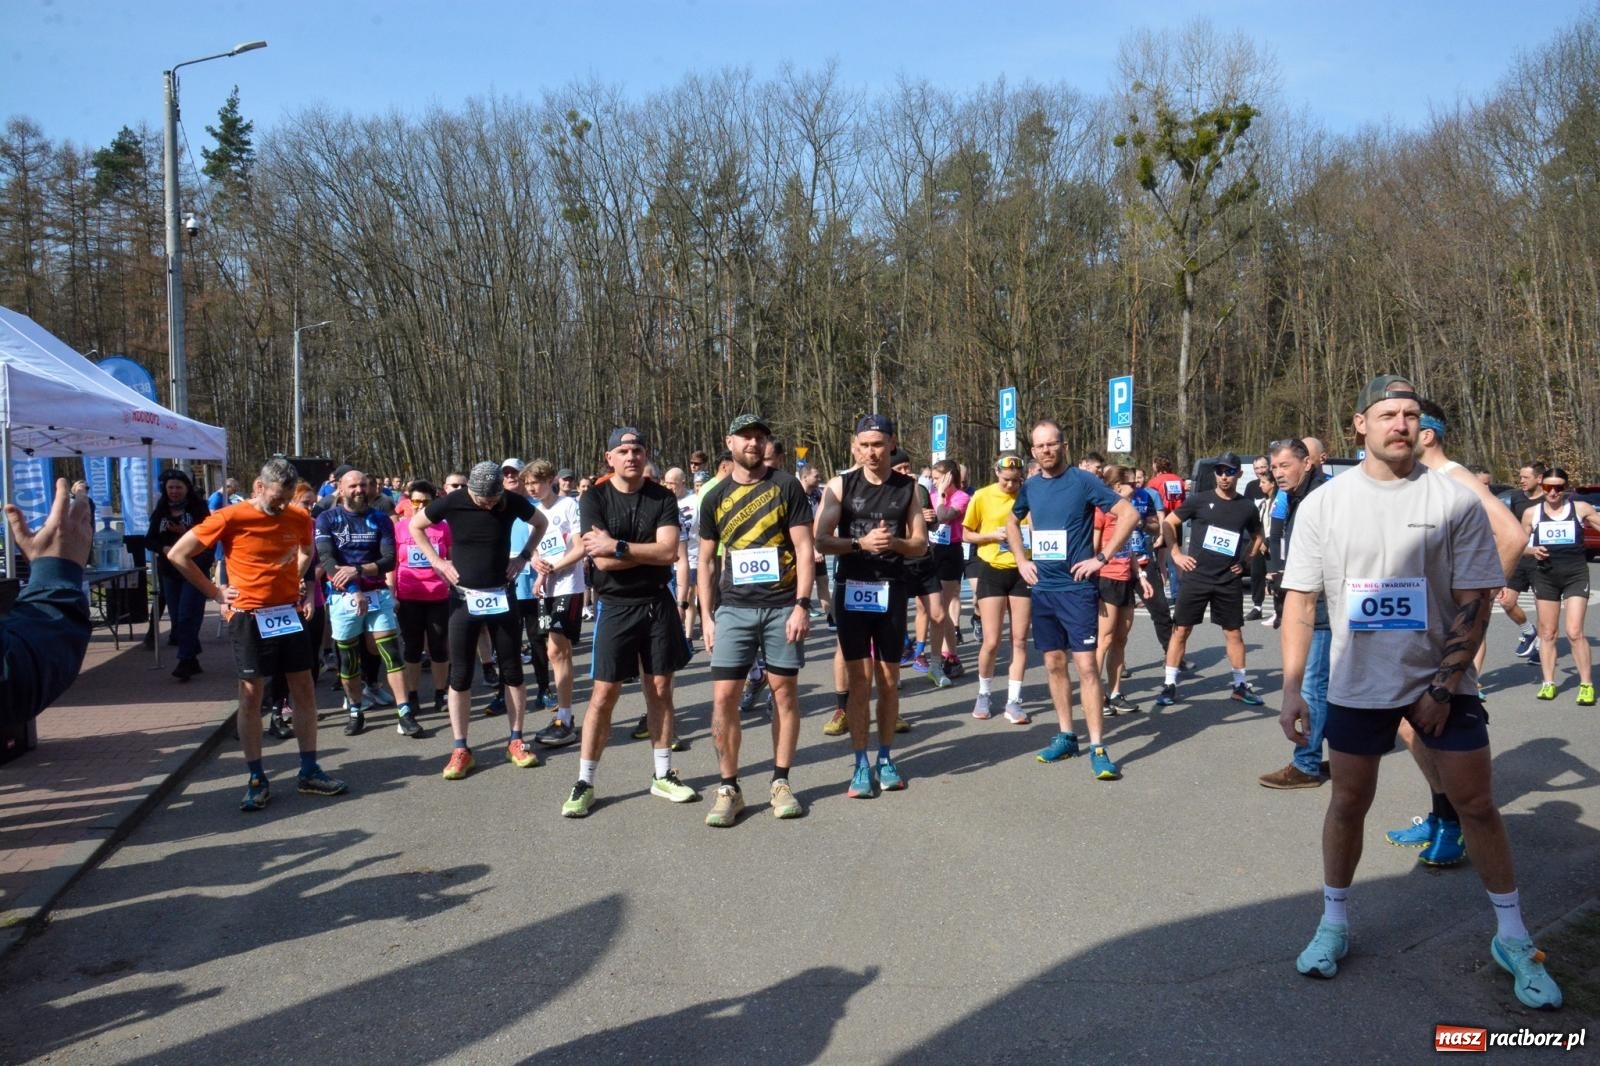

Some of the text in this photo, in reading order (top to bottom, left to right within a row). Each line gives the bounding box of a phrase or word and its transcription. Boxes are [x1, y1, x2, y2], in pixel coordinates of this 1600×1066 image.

[1114, 382, 1127, 413] P
[1003, 393, 1012, 418] P
[935, 418, 944, 441] P
[1546, 529, 1567, 538] 031
[540, 536, 557, 551] 037
[1038, 541, 1059, 552] 104
[1213, 536, 1231, 548] 125
[739, 560, 771, 574] 080
[475, 597, 499, 609] 021
[853, 590, 879, 603] 051
[1361, 597, 1412, 617] 055
[265, 615, 292, 629] 076
